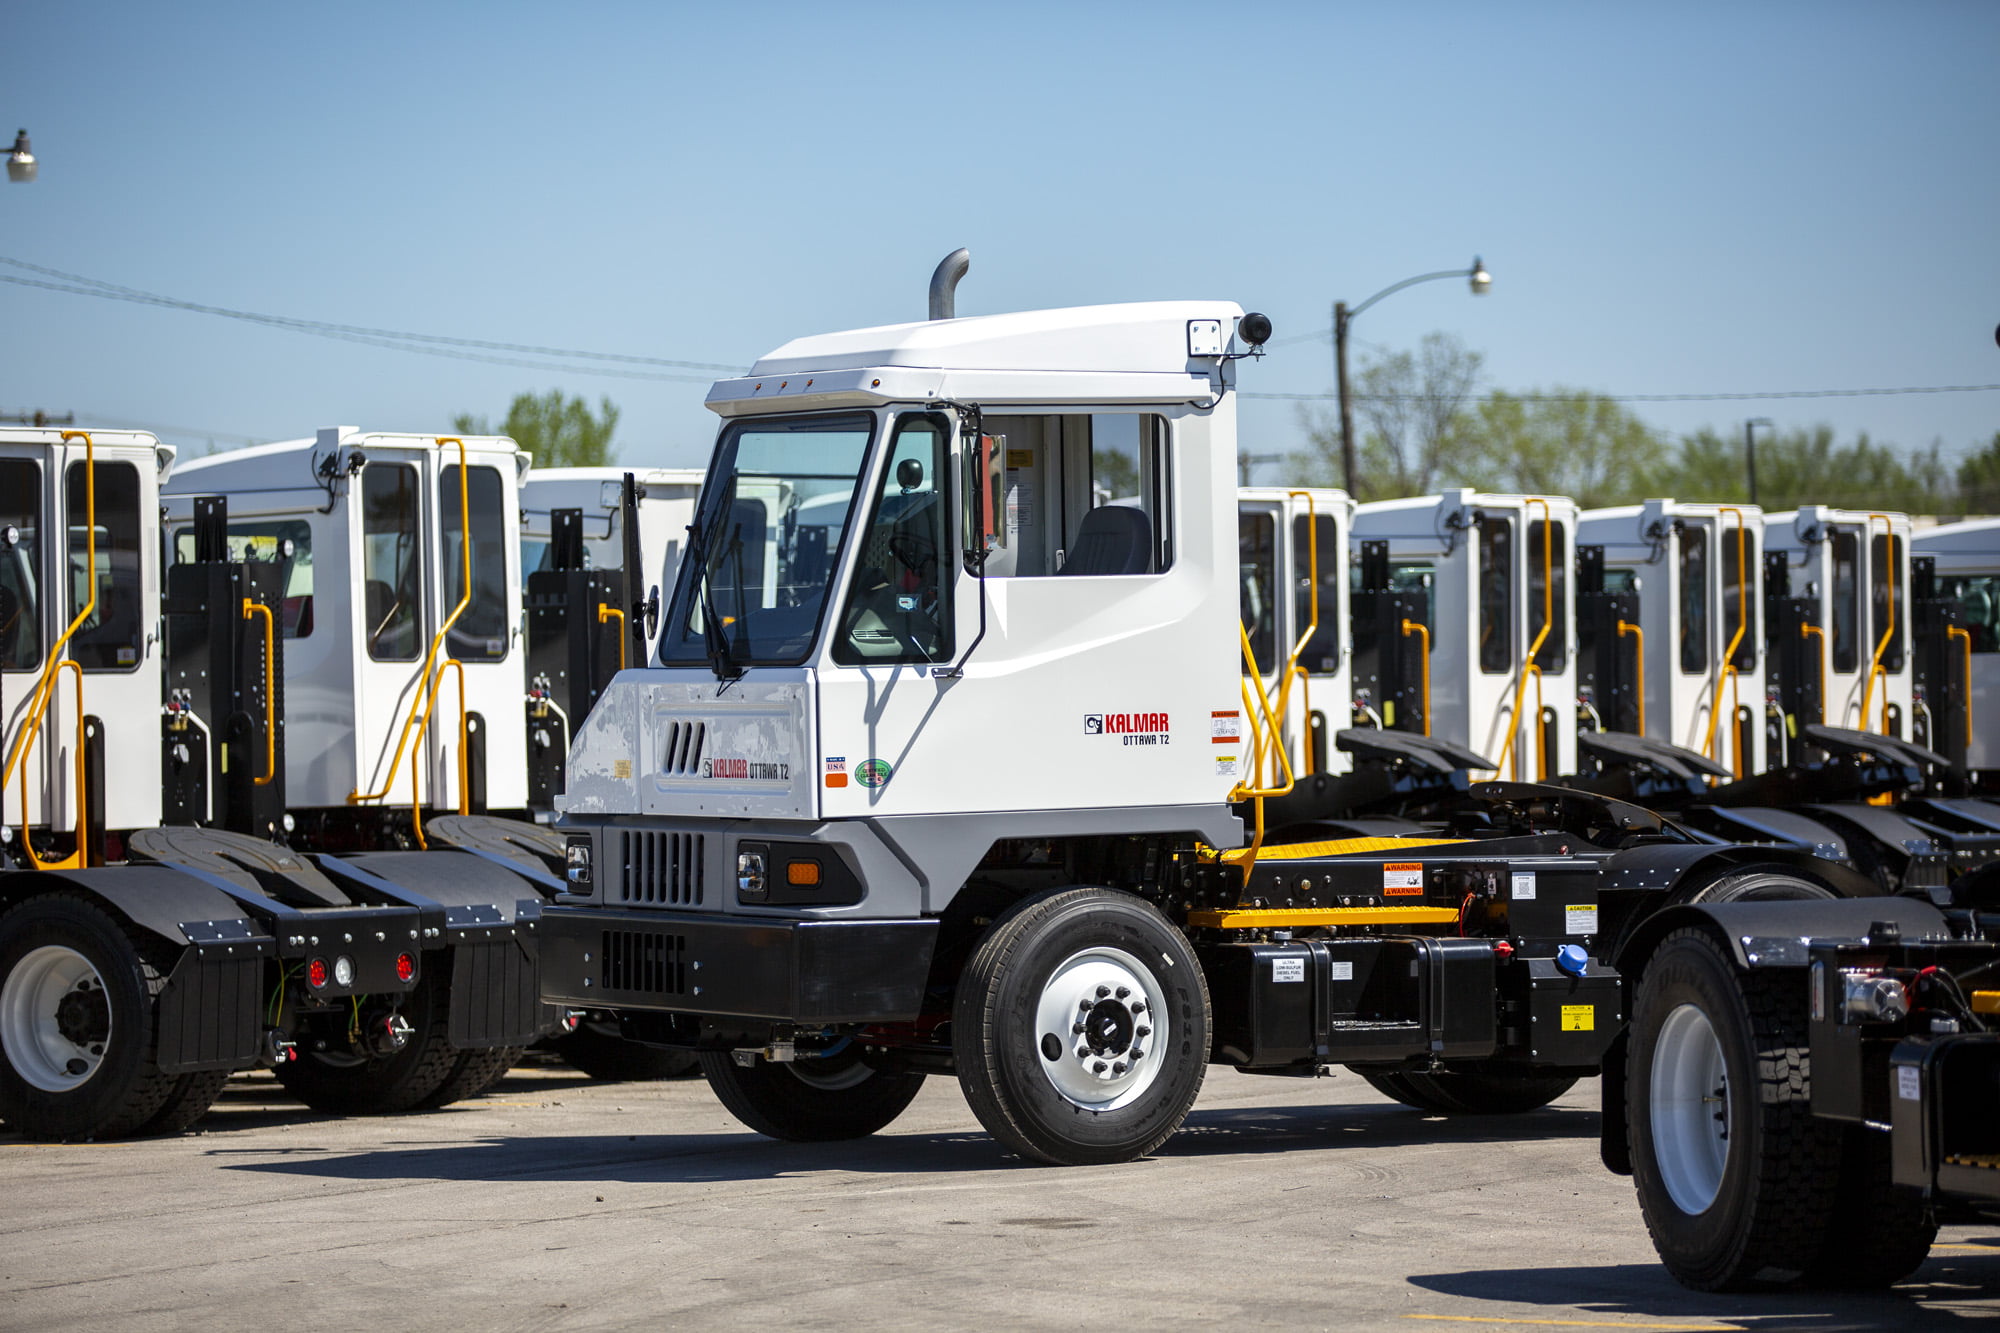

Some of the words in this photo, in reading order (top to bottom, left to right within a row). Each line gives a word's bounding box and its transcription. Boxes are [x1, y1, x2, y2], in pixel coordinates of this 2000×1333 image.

[1105, 713, 1169, 733] KALMAR
[1123, 735, 1157, 746] OTTAWA
[1160, 734, 1170, 745] T2
[713, 758, 748, 779] KALMAR
[749, 763, 778, 780] OTTAWA
[780, 763, 789, 780] T2
[827, 763, 845, 771] USA
